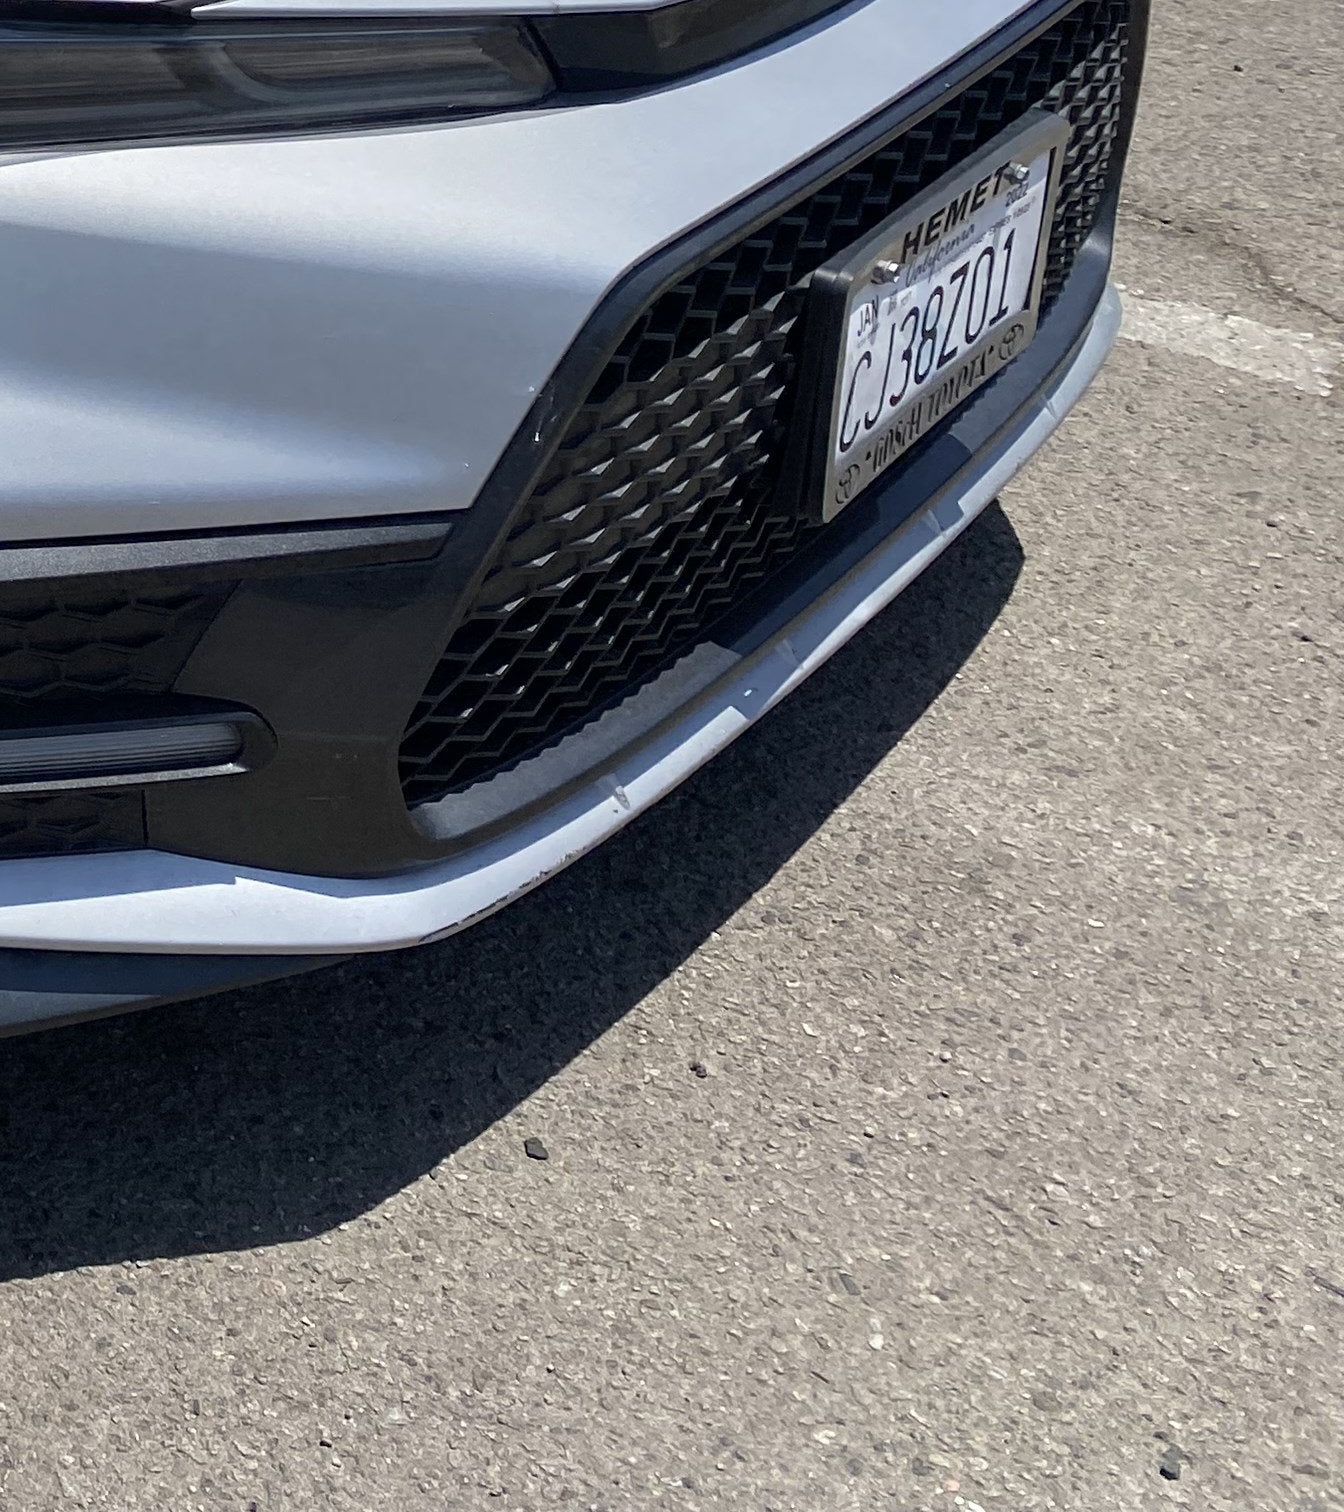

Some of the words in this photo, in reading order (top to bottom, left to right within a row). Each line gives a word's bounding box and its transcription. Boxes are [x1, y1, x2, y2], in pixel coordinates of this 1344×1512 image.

[900, 161, 1011, 264] HEMET
[839, 228, 1016, 453] CJ38Z01
[856, 294, 879, 337] JAN
